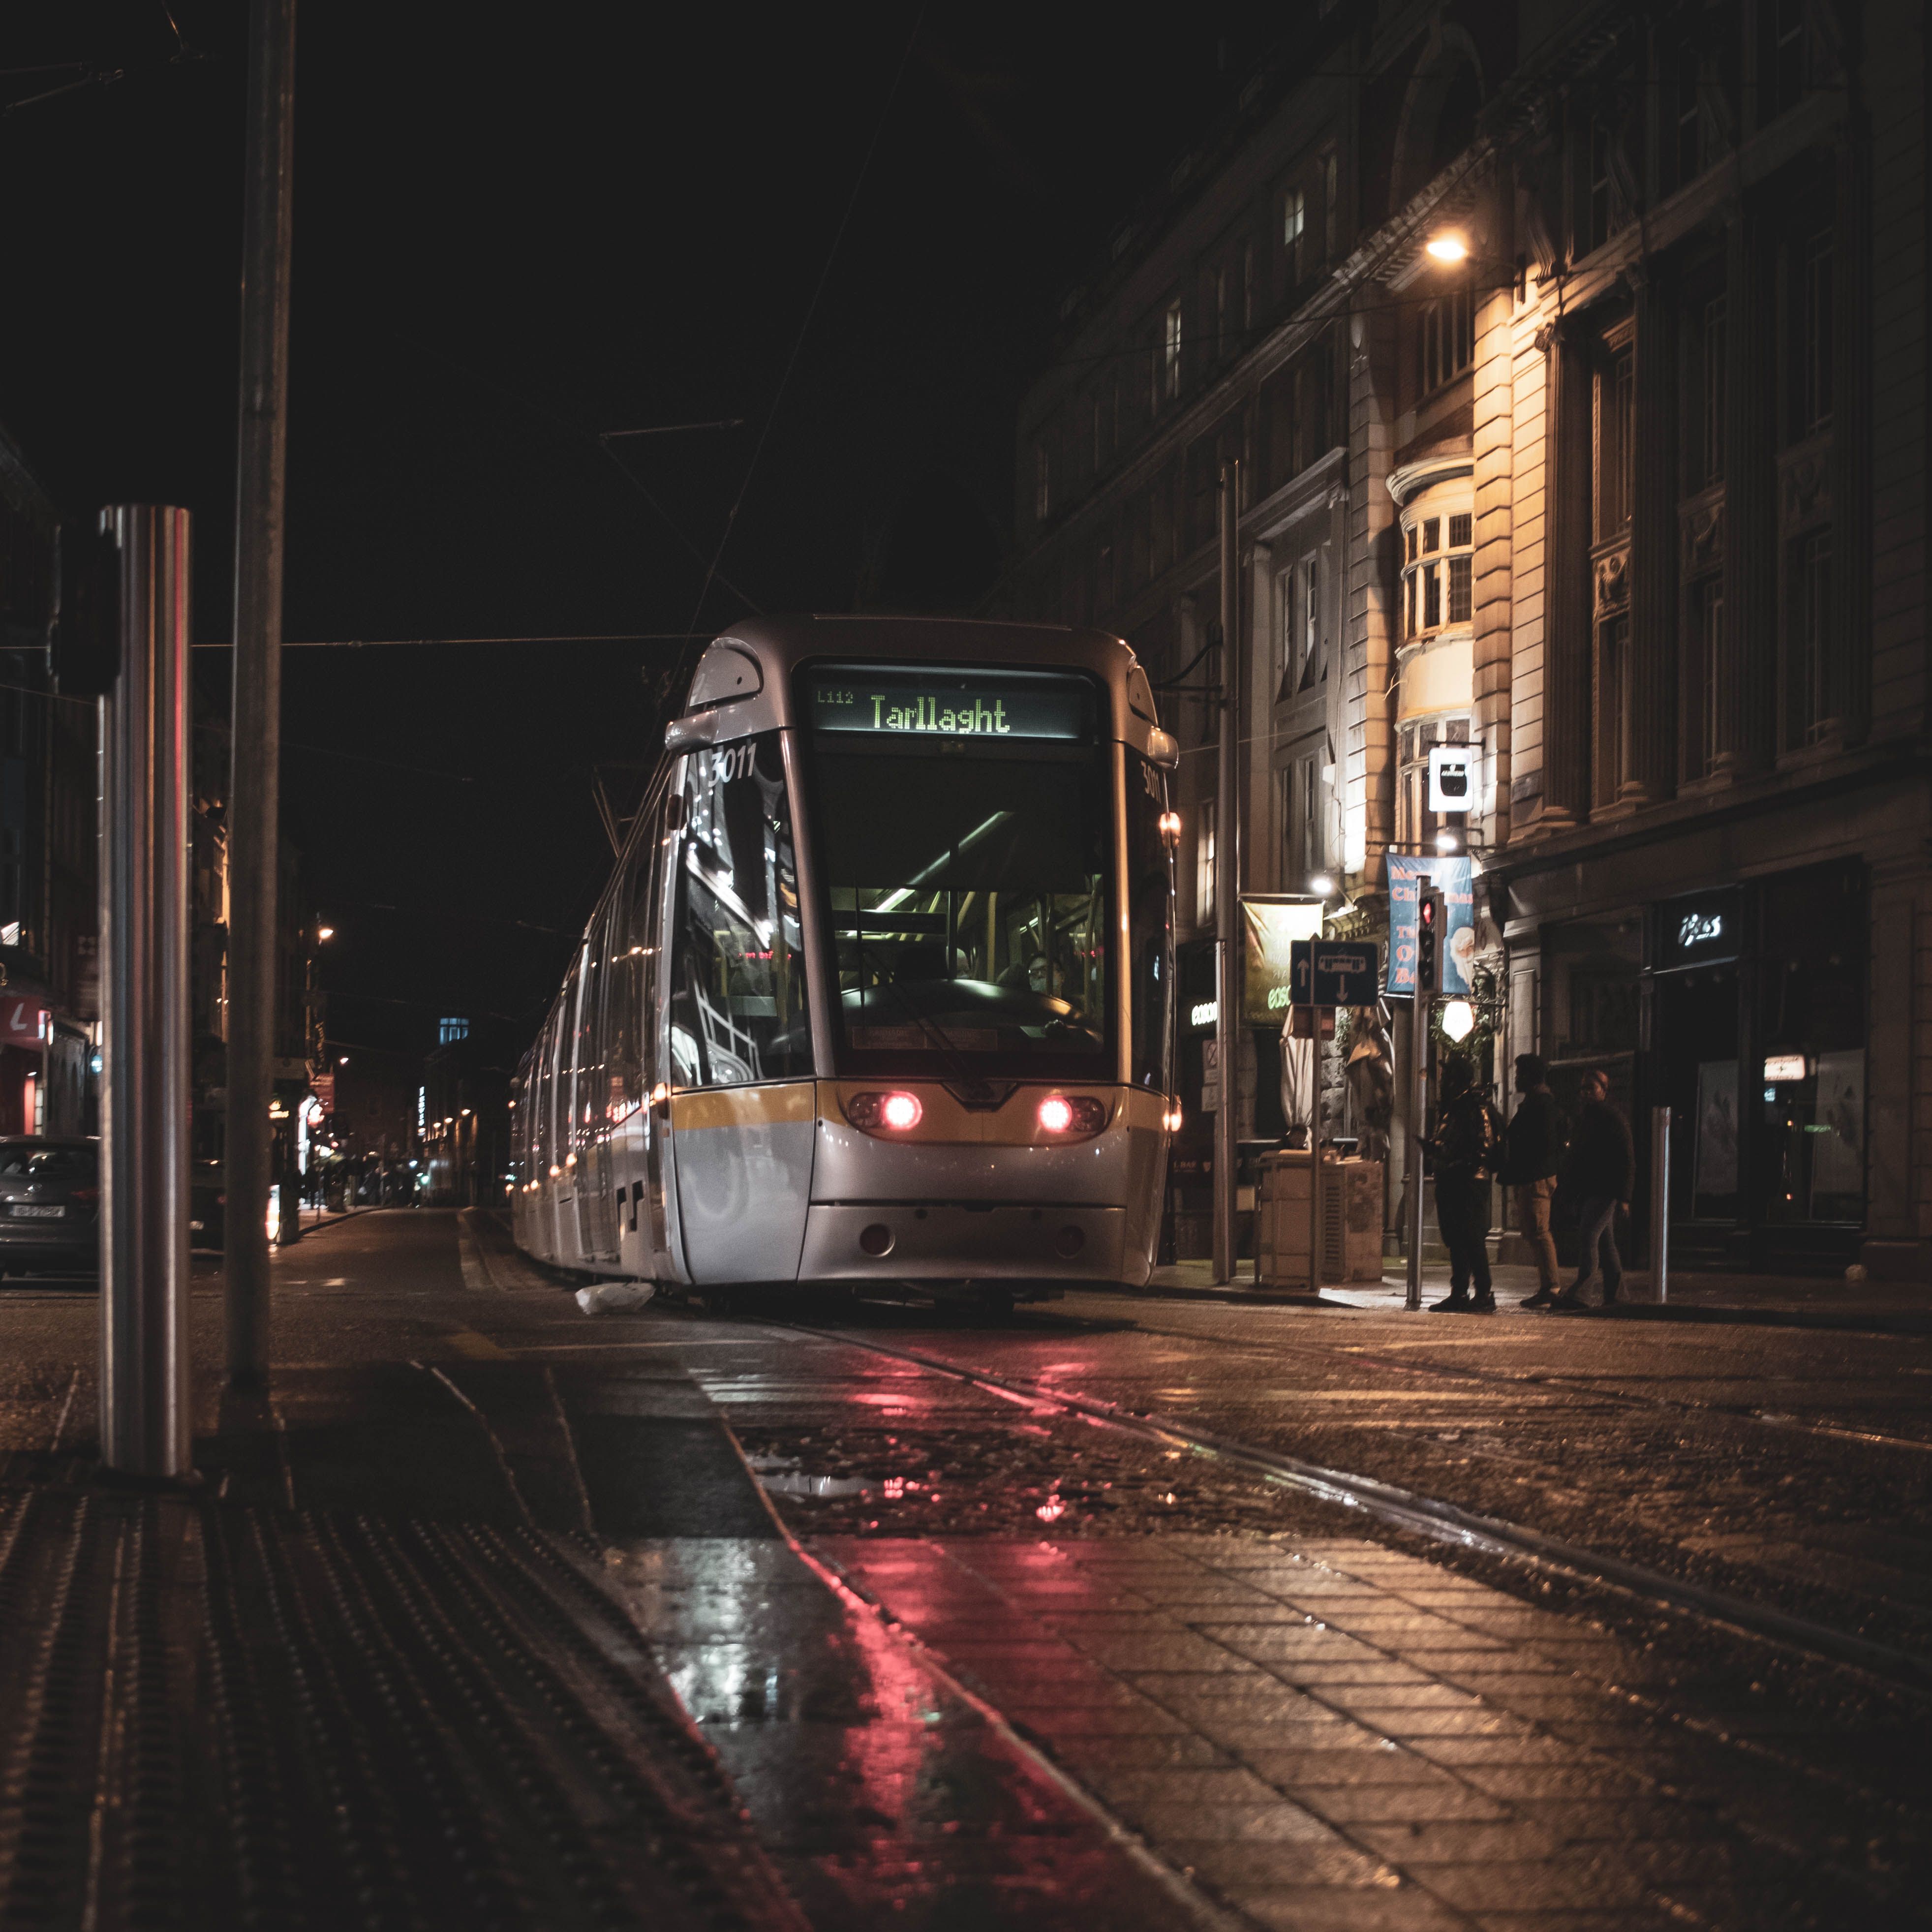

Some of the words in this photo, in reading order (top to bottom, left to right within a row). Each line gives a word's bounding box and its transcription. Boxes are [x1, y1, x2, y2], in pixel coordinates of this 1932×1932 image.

[817, 690, 854, 705] L112
[871, 694, 1011, 734] Tarllaght
[708, 742, 757, 788] 3011
[1141, 760, 1161, 804] 3011
[1391, 887, 1473, 904] Chmas
[1396, 925, 1415, 939] Th
[1395, 967, 1415, 984] Ba
[1268, 985, 1291, 1010] eas
